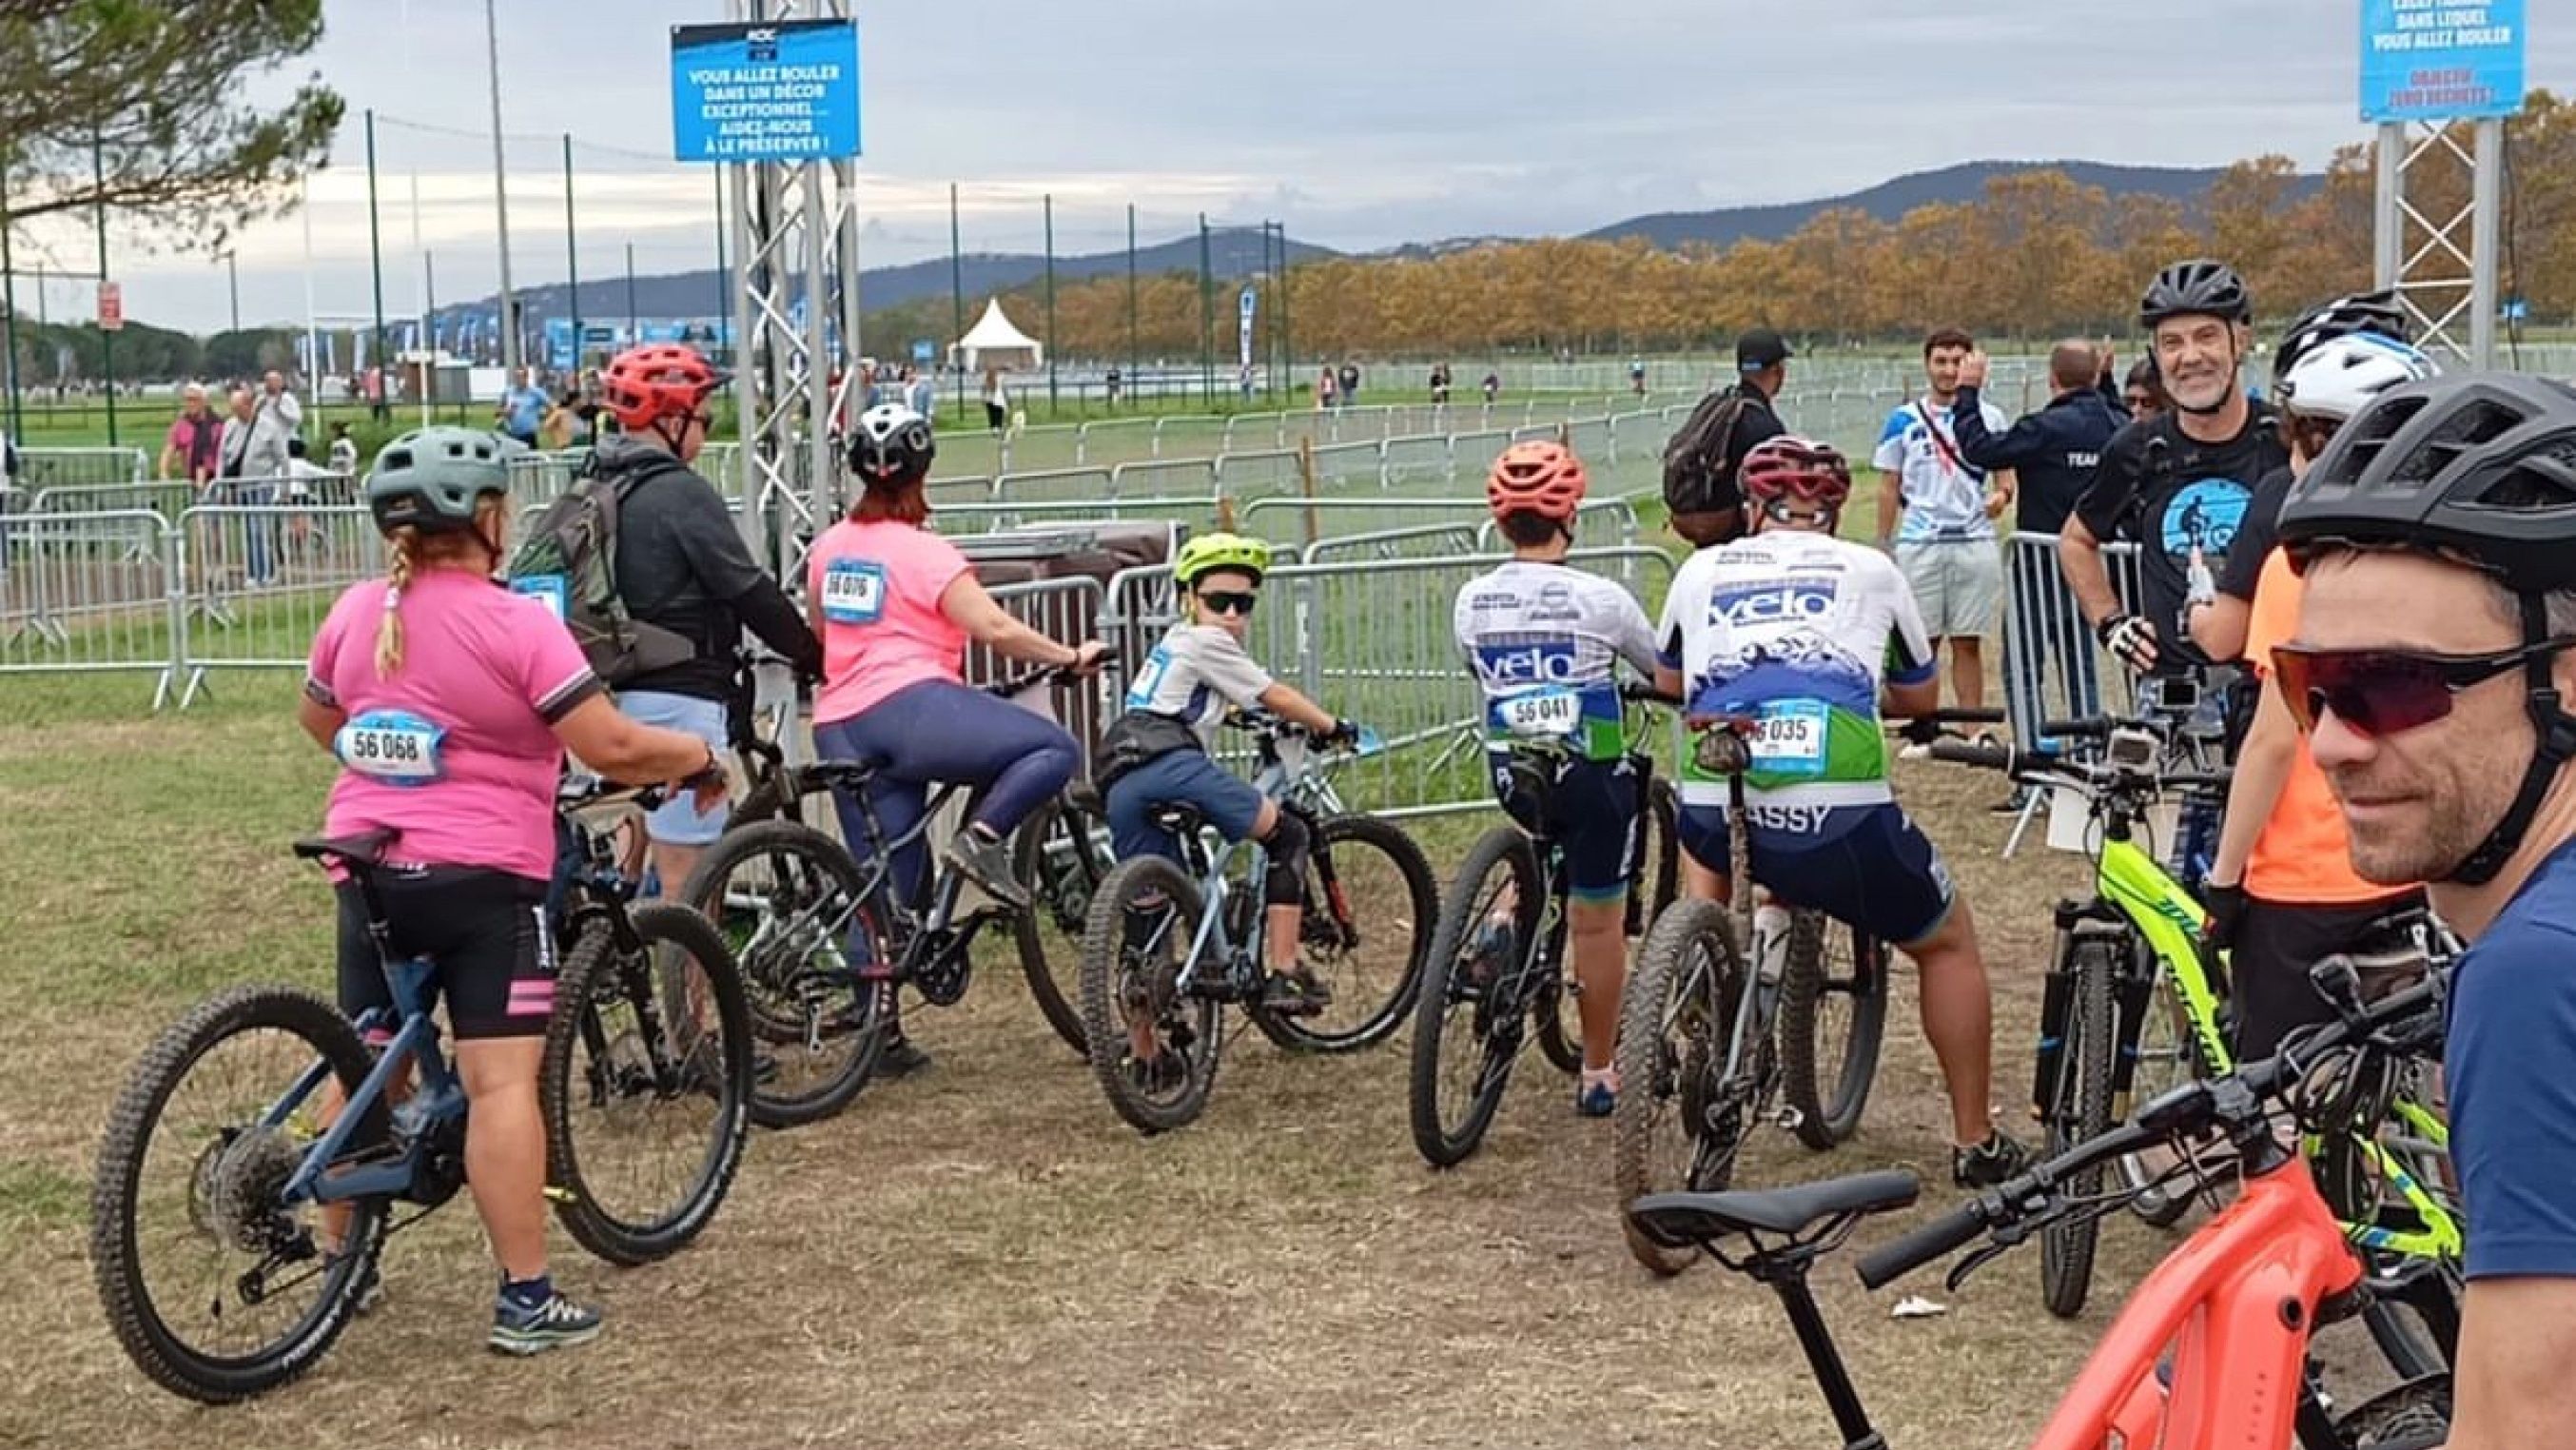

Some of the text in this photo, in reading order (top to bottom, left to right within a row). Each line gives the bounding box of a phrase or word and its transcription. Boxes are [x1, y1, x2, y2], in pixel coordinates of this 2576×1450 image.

[2373, 27, 2510, 49] VOUS ALLEZ ROULER
[689, 65, 839, 84] VOUS ALLEZ ROULER
[704, 86, 744, 100] DANS
[749, 85, 770, 100] UN
[720, 120, 812, 135] AIDEZ-NOUS
[719, 138, 734, 153] LE
[1515, 698, 1569, 722] 56 041
[1770, 718, 1807, 741] 035
[355, 731, 417, 761] 56 068
